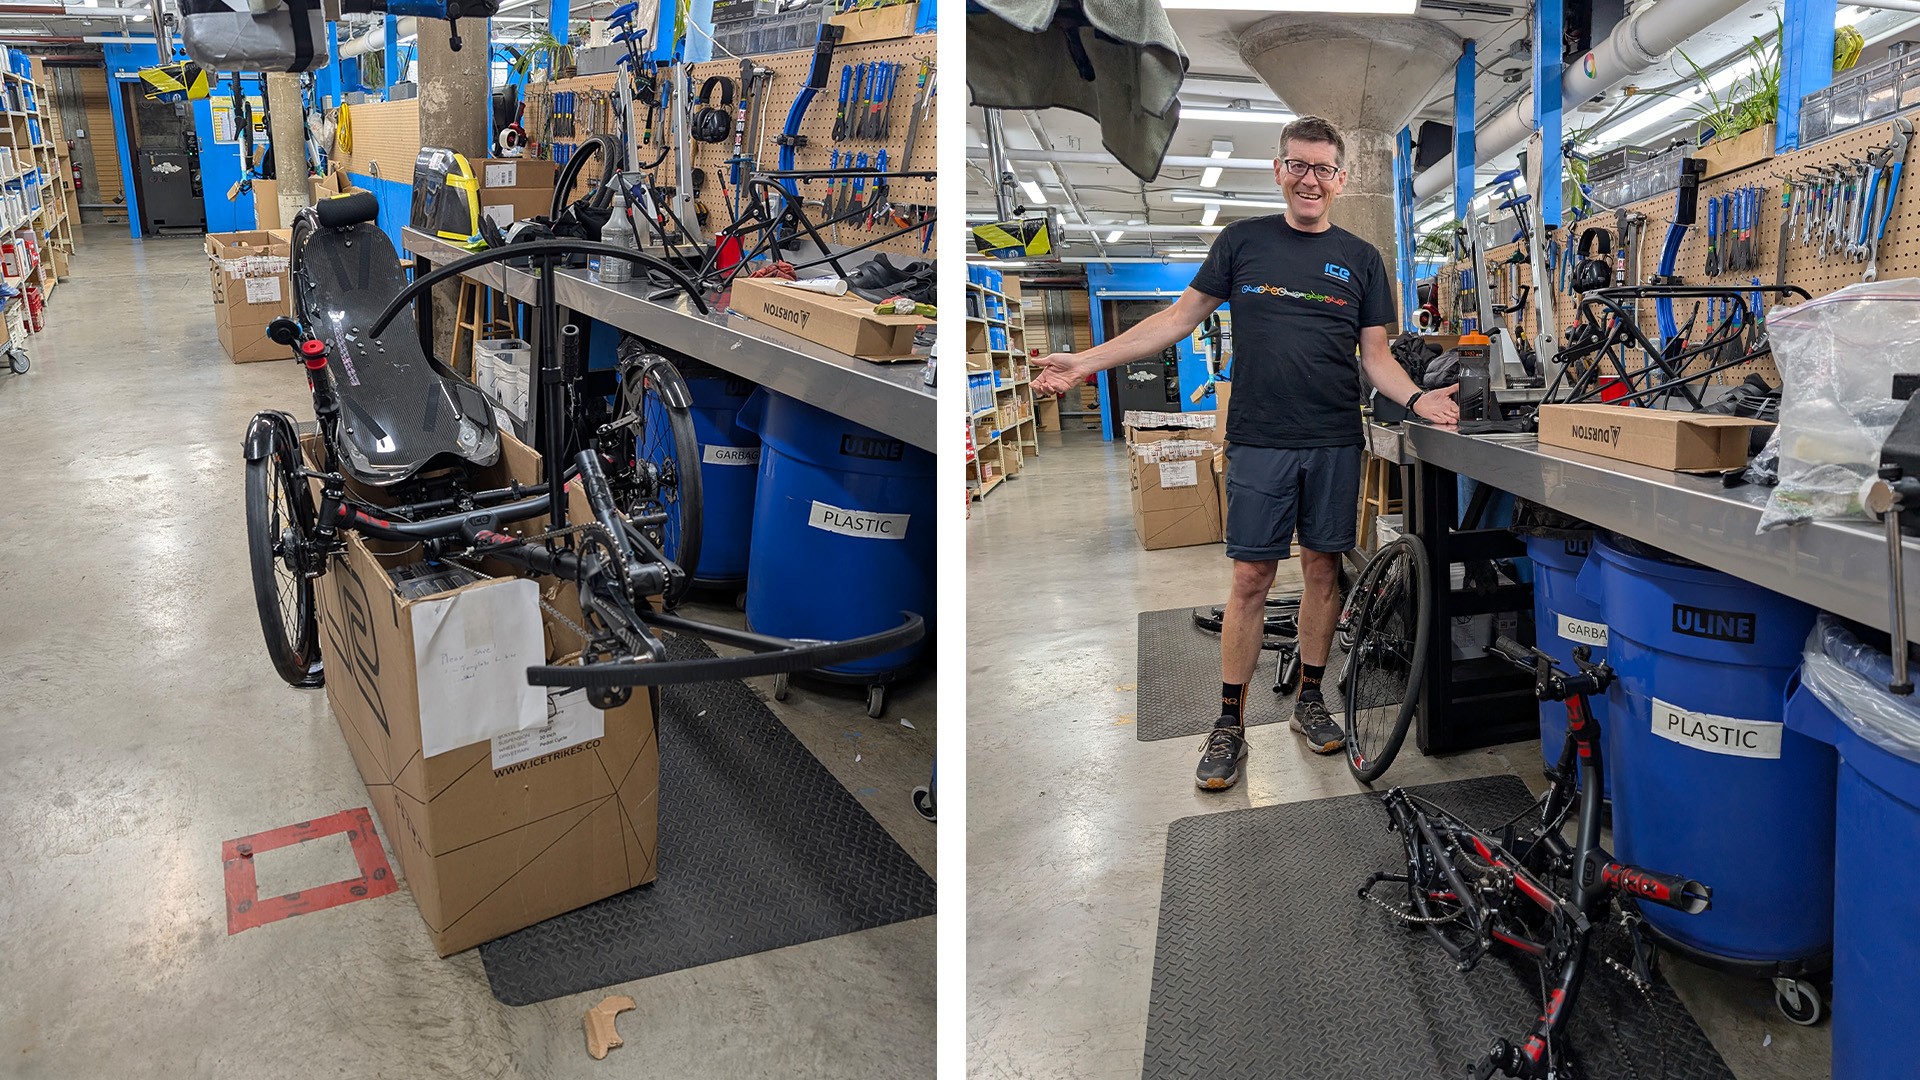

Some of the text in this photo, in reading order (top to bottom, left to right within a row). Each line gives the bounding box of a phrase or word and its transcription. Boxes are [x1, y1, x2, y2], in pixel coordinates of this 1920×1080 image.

[763, 302, 799, 324] DURSTON
[1572, 425, 1610, 443] DURSTON
[715, 449, 760, 460] GARBAG
[844, 438, 901, 458] ULINE
[823, 511, 892, 533] PLASTIC
[1567, 622, 1608, 640] GARBA
[1676, 609, 1750, 639] ULINE
[1668, 713, 1758, 749] PLASTIC
[494, 739, 601, 778] WWW.ICETRIKES.CO
